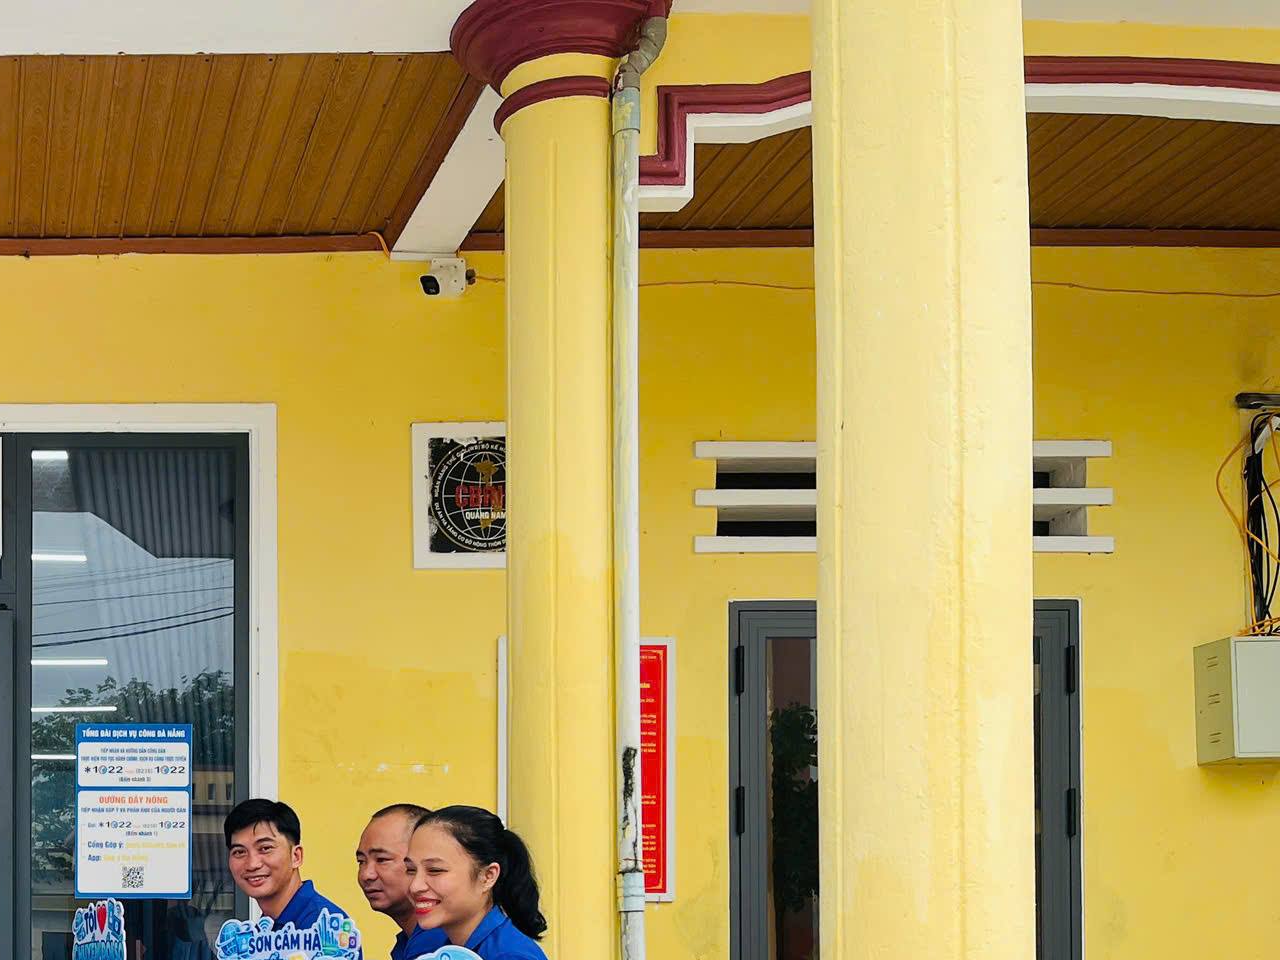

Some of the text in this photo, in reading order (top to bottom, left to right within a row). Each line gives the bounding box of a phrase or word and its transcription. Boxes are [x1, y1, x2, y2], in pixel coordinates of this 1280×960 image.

[82, 727, 99, 738] TỔNG
[100, 728, 111, 737] ĐÀI
[129, 730, 137, 738] VỤ
[139, 728, 156, 737] CÔNG
[157, 728, 166, 737] ĐÀ
[249, 925, 322, 954] SƠN CẨM HÀ
